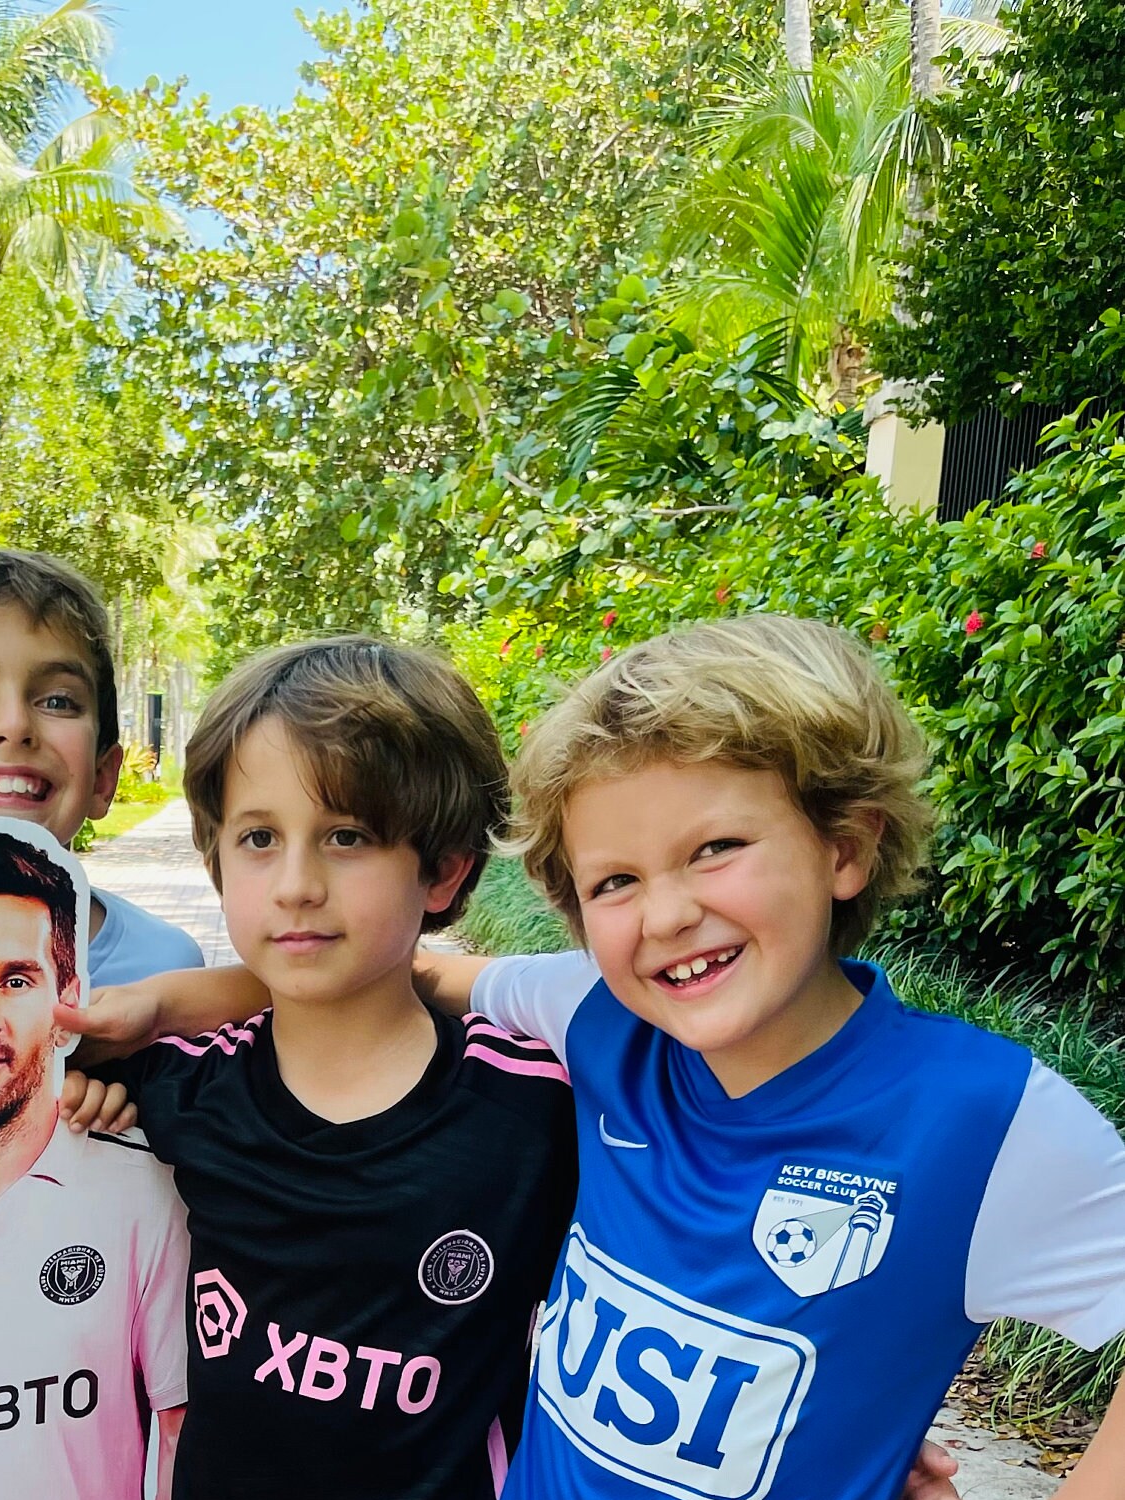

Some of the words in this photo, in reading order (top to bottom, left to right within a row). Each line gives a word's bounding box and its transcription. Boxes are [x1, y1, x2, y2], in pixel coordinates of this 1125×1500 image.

[777, 1176, 822, 1191] SOCCER
[824, 1184, 858, 1198] CLUB
[781, 1165, 814, 1178] KEY
[815, 1169, 897, 1194] BISCAYNE
[254, 1321, 441, 1414] XBTO
[557, 1264, 760, 1470] USI
